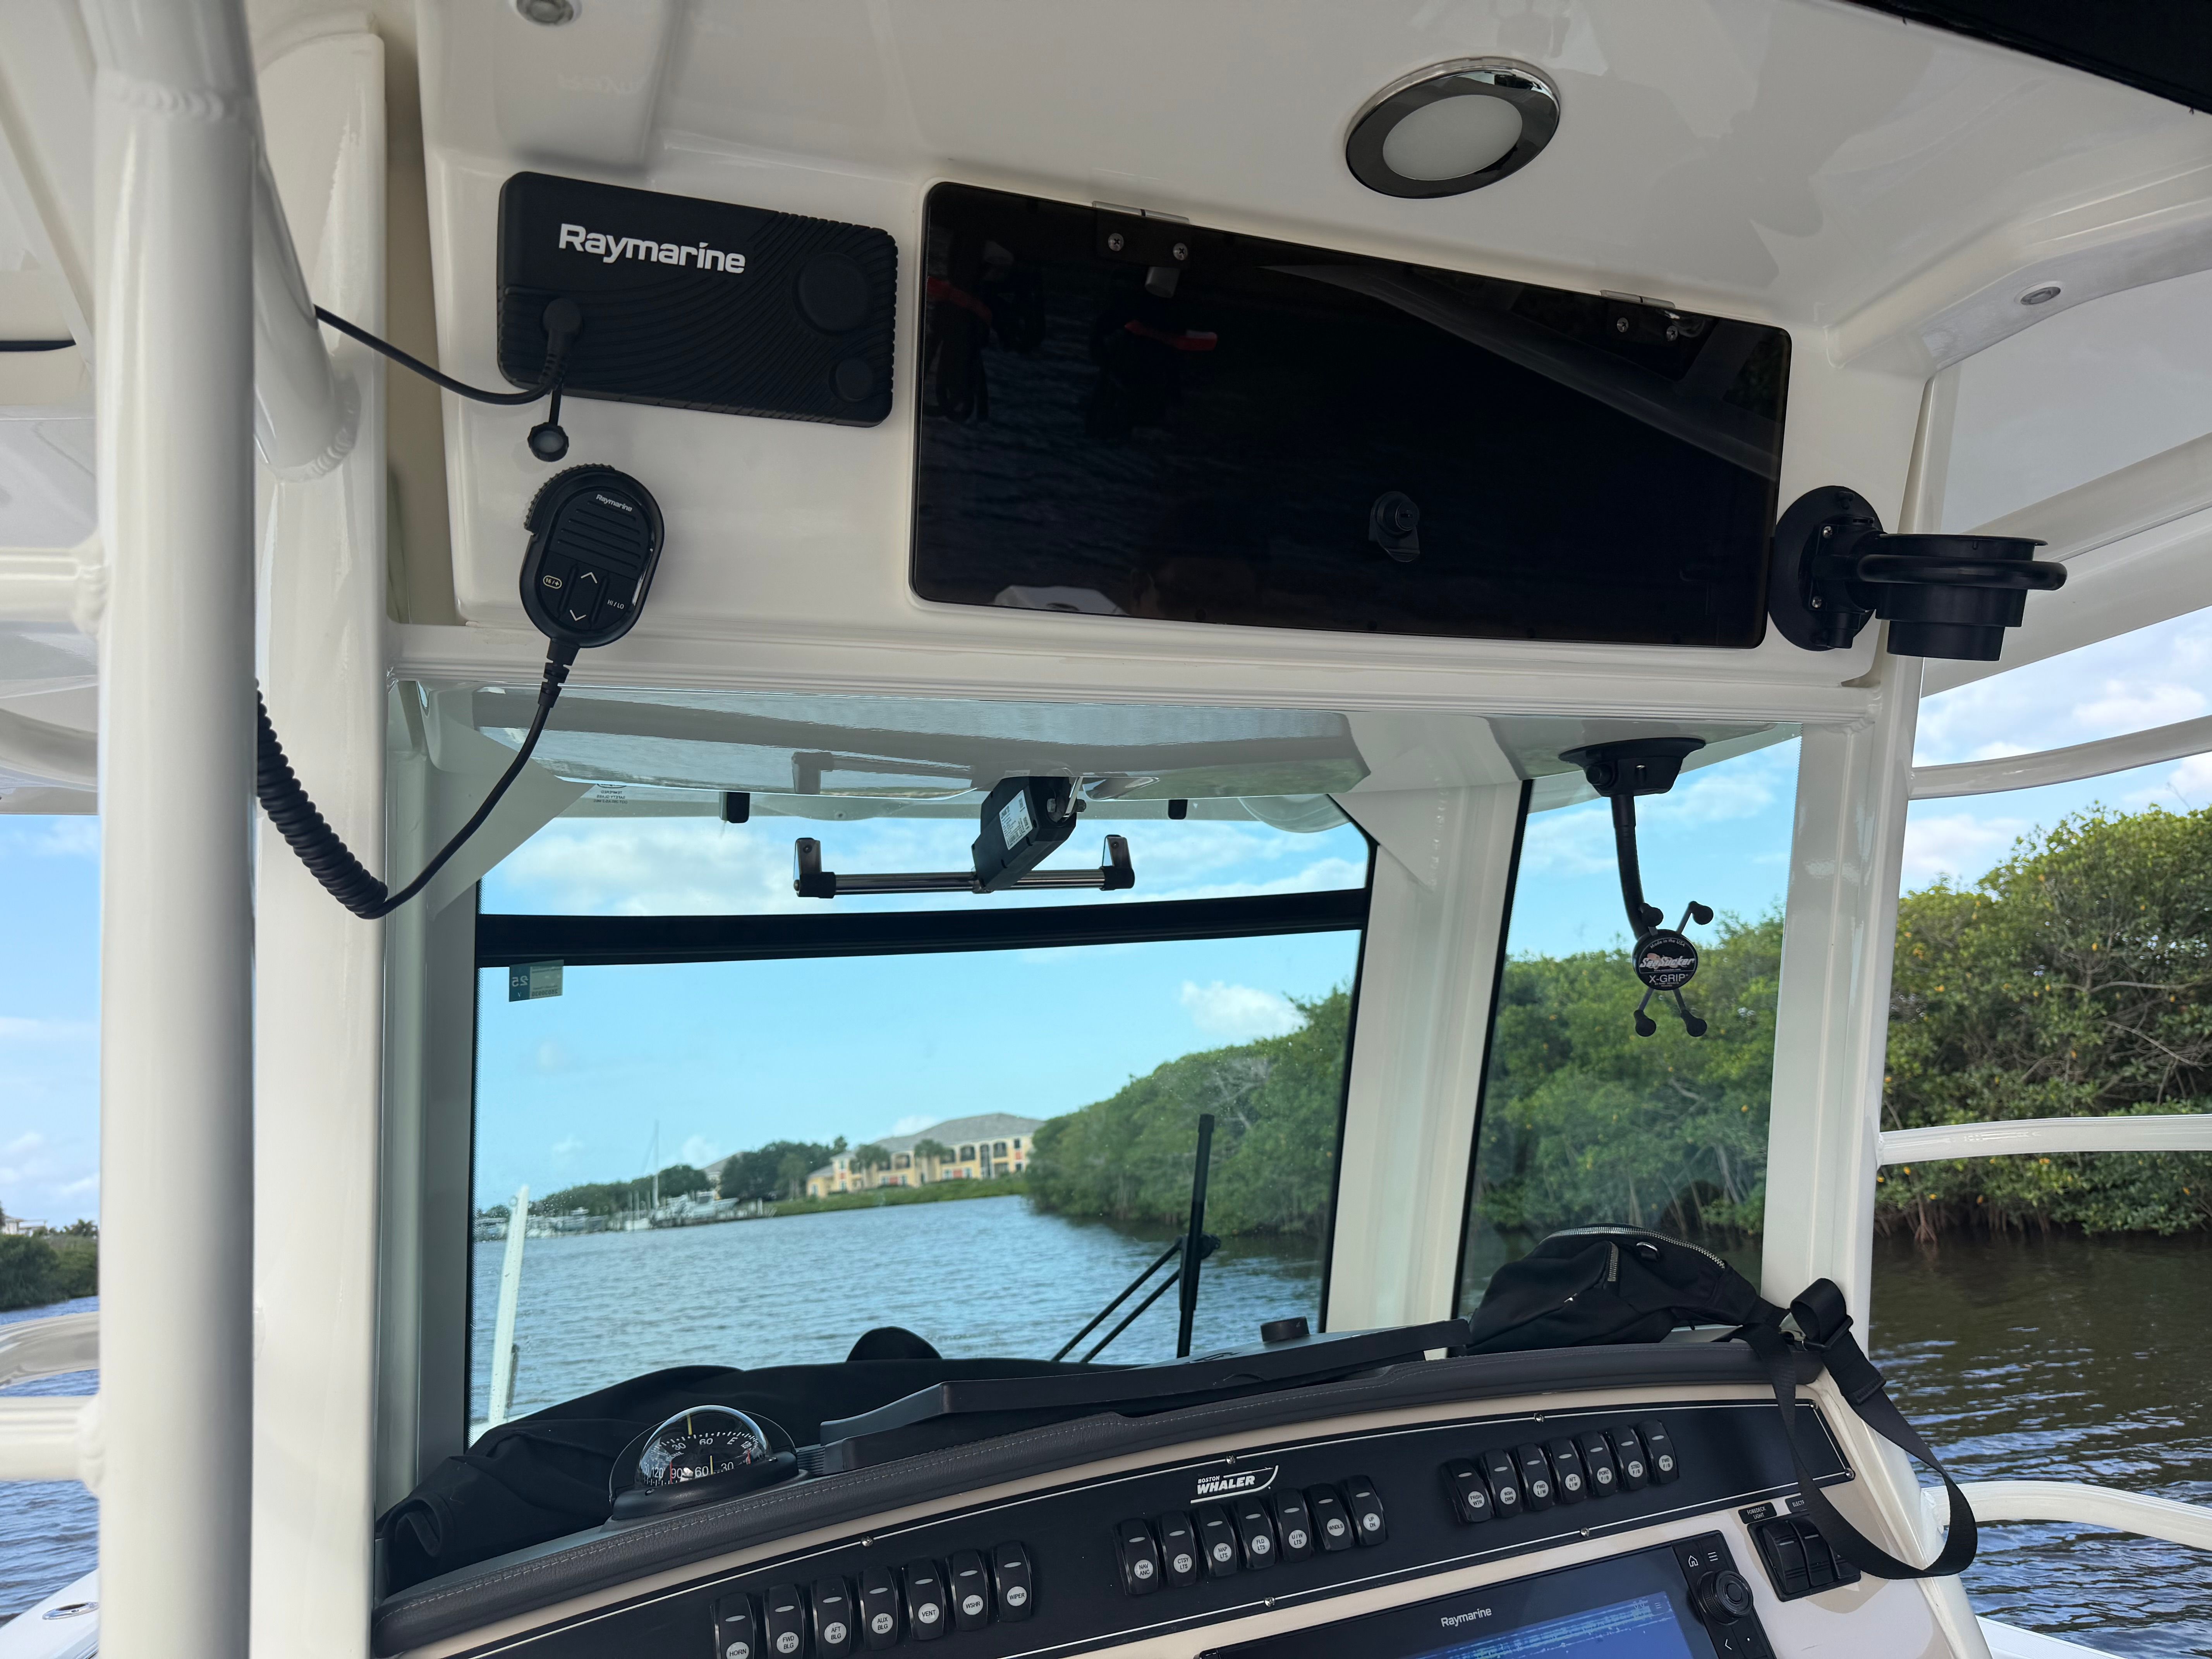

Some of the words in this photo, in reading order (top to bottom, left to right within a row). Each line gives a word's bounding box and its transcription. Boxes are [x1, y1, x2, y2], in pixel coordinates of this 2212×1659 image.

[559, 223, 745, 274] Raymarine
[596, 494, 632, 512] Raymarine
[1650, 941, 1662, 949] Made
[1639, 956, 1695, 968] SeaSucker
[651, 1467, 664, 1478] 120
[671, 1468, 683, 1479] 90
[695, 1466, 709, 1477] 60
[721, 1462, 733, 1471] 30
[1197, 1475, 1255, 1494] WHALER
[1198, 1475, 1220, 1484] BOSTON
[1441, 1608, 1492, 1627] Raymarine
[729, 1649, 747, 1657] HORN
